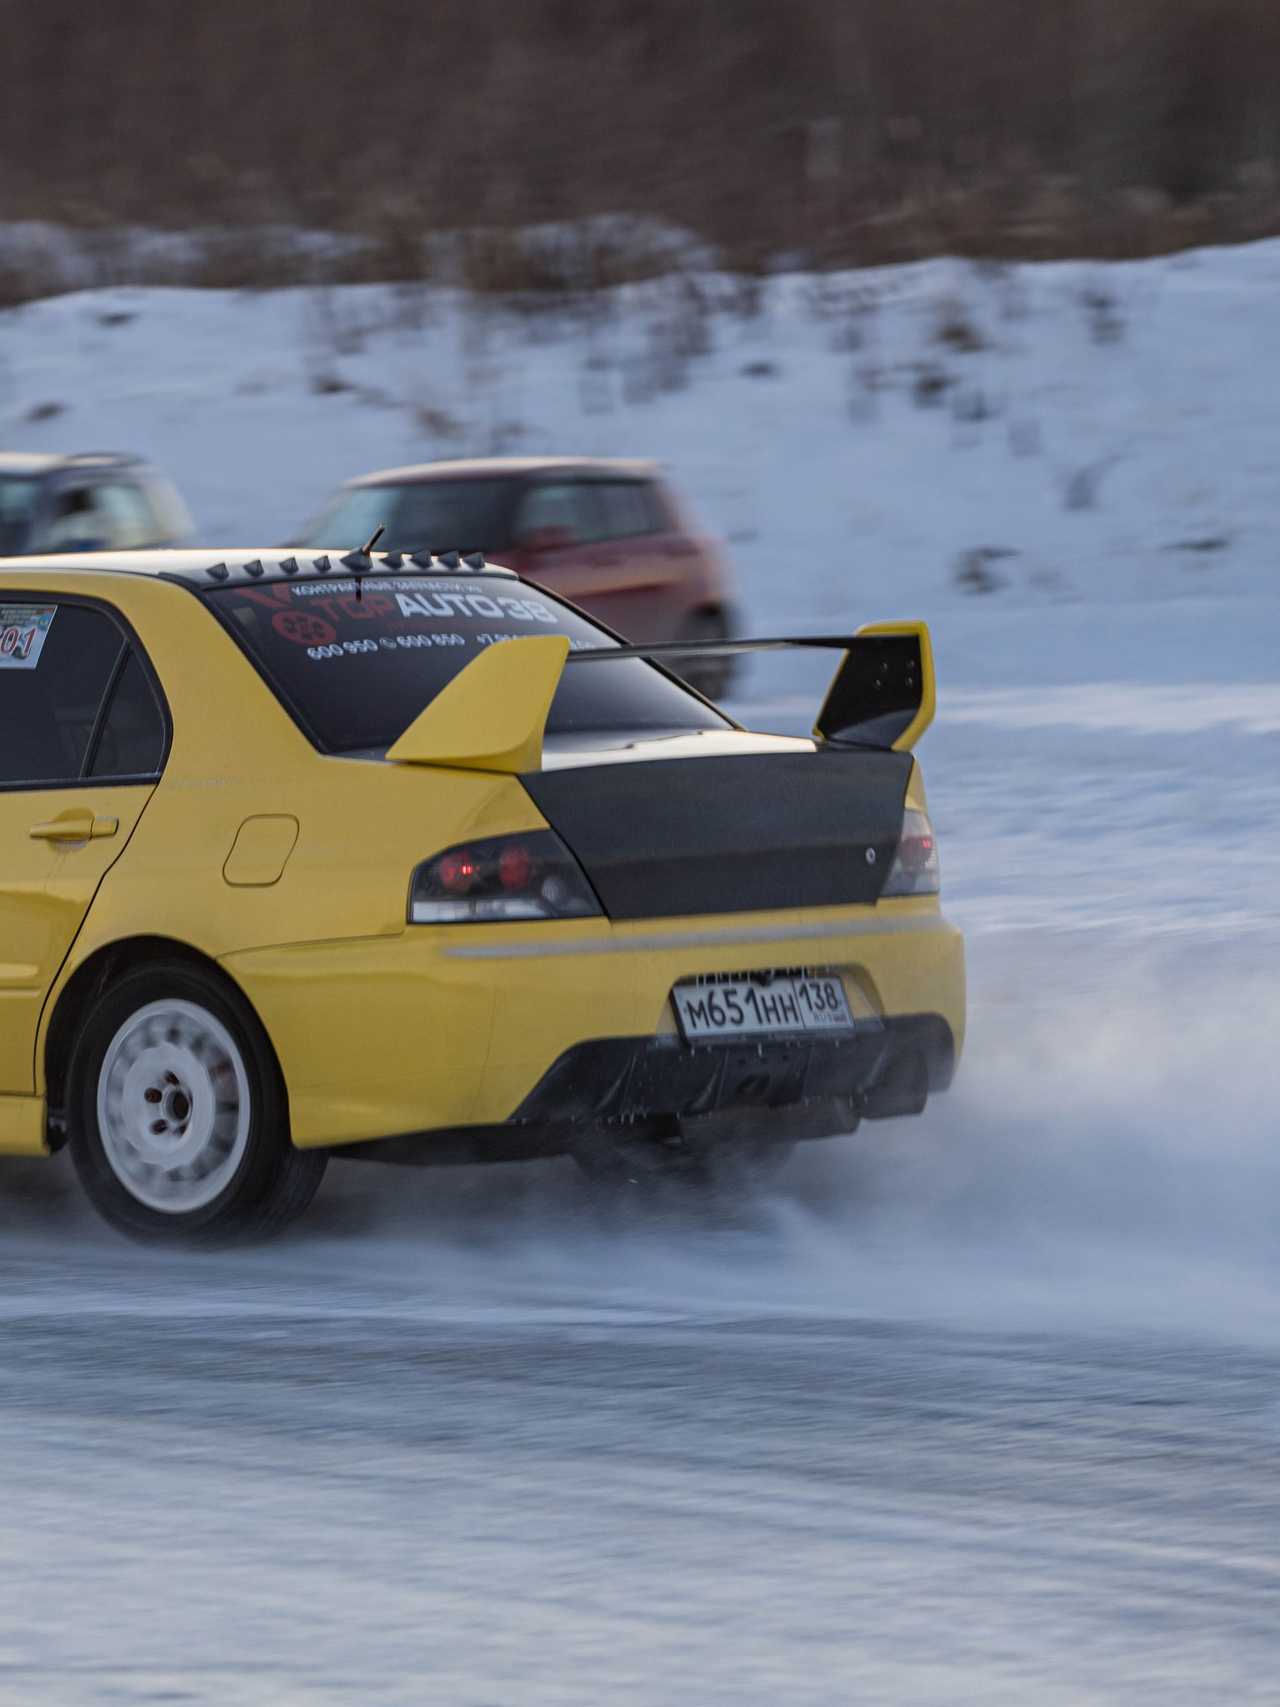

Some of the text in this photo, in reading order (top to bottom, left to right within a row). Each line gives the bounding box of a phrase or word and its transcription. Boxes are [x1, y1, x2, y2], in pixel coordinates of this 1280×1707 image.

[307, 644, 344, 660] 600
[343, 639, 378, 654] 950
[396, 634, 432, 648] 600
[799, 982, 839, 1012] 138
